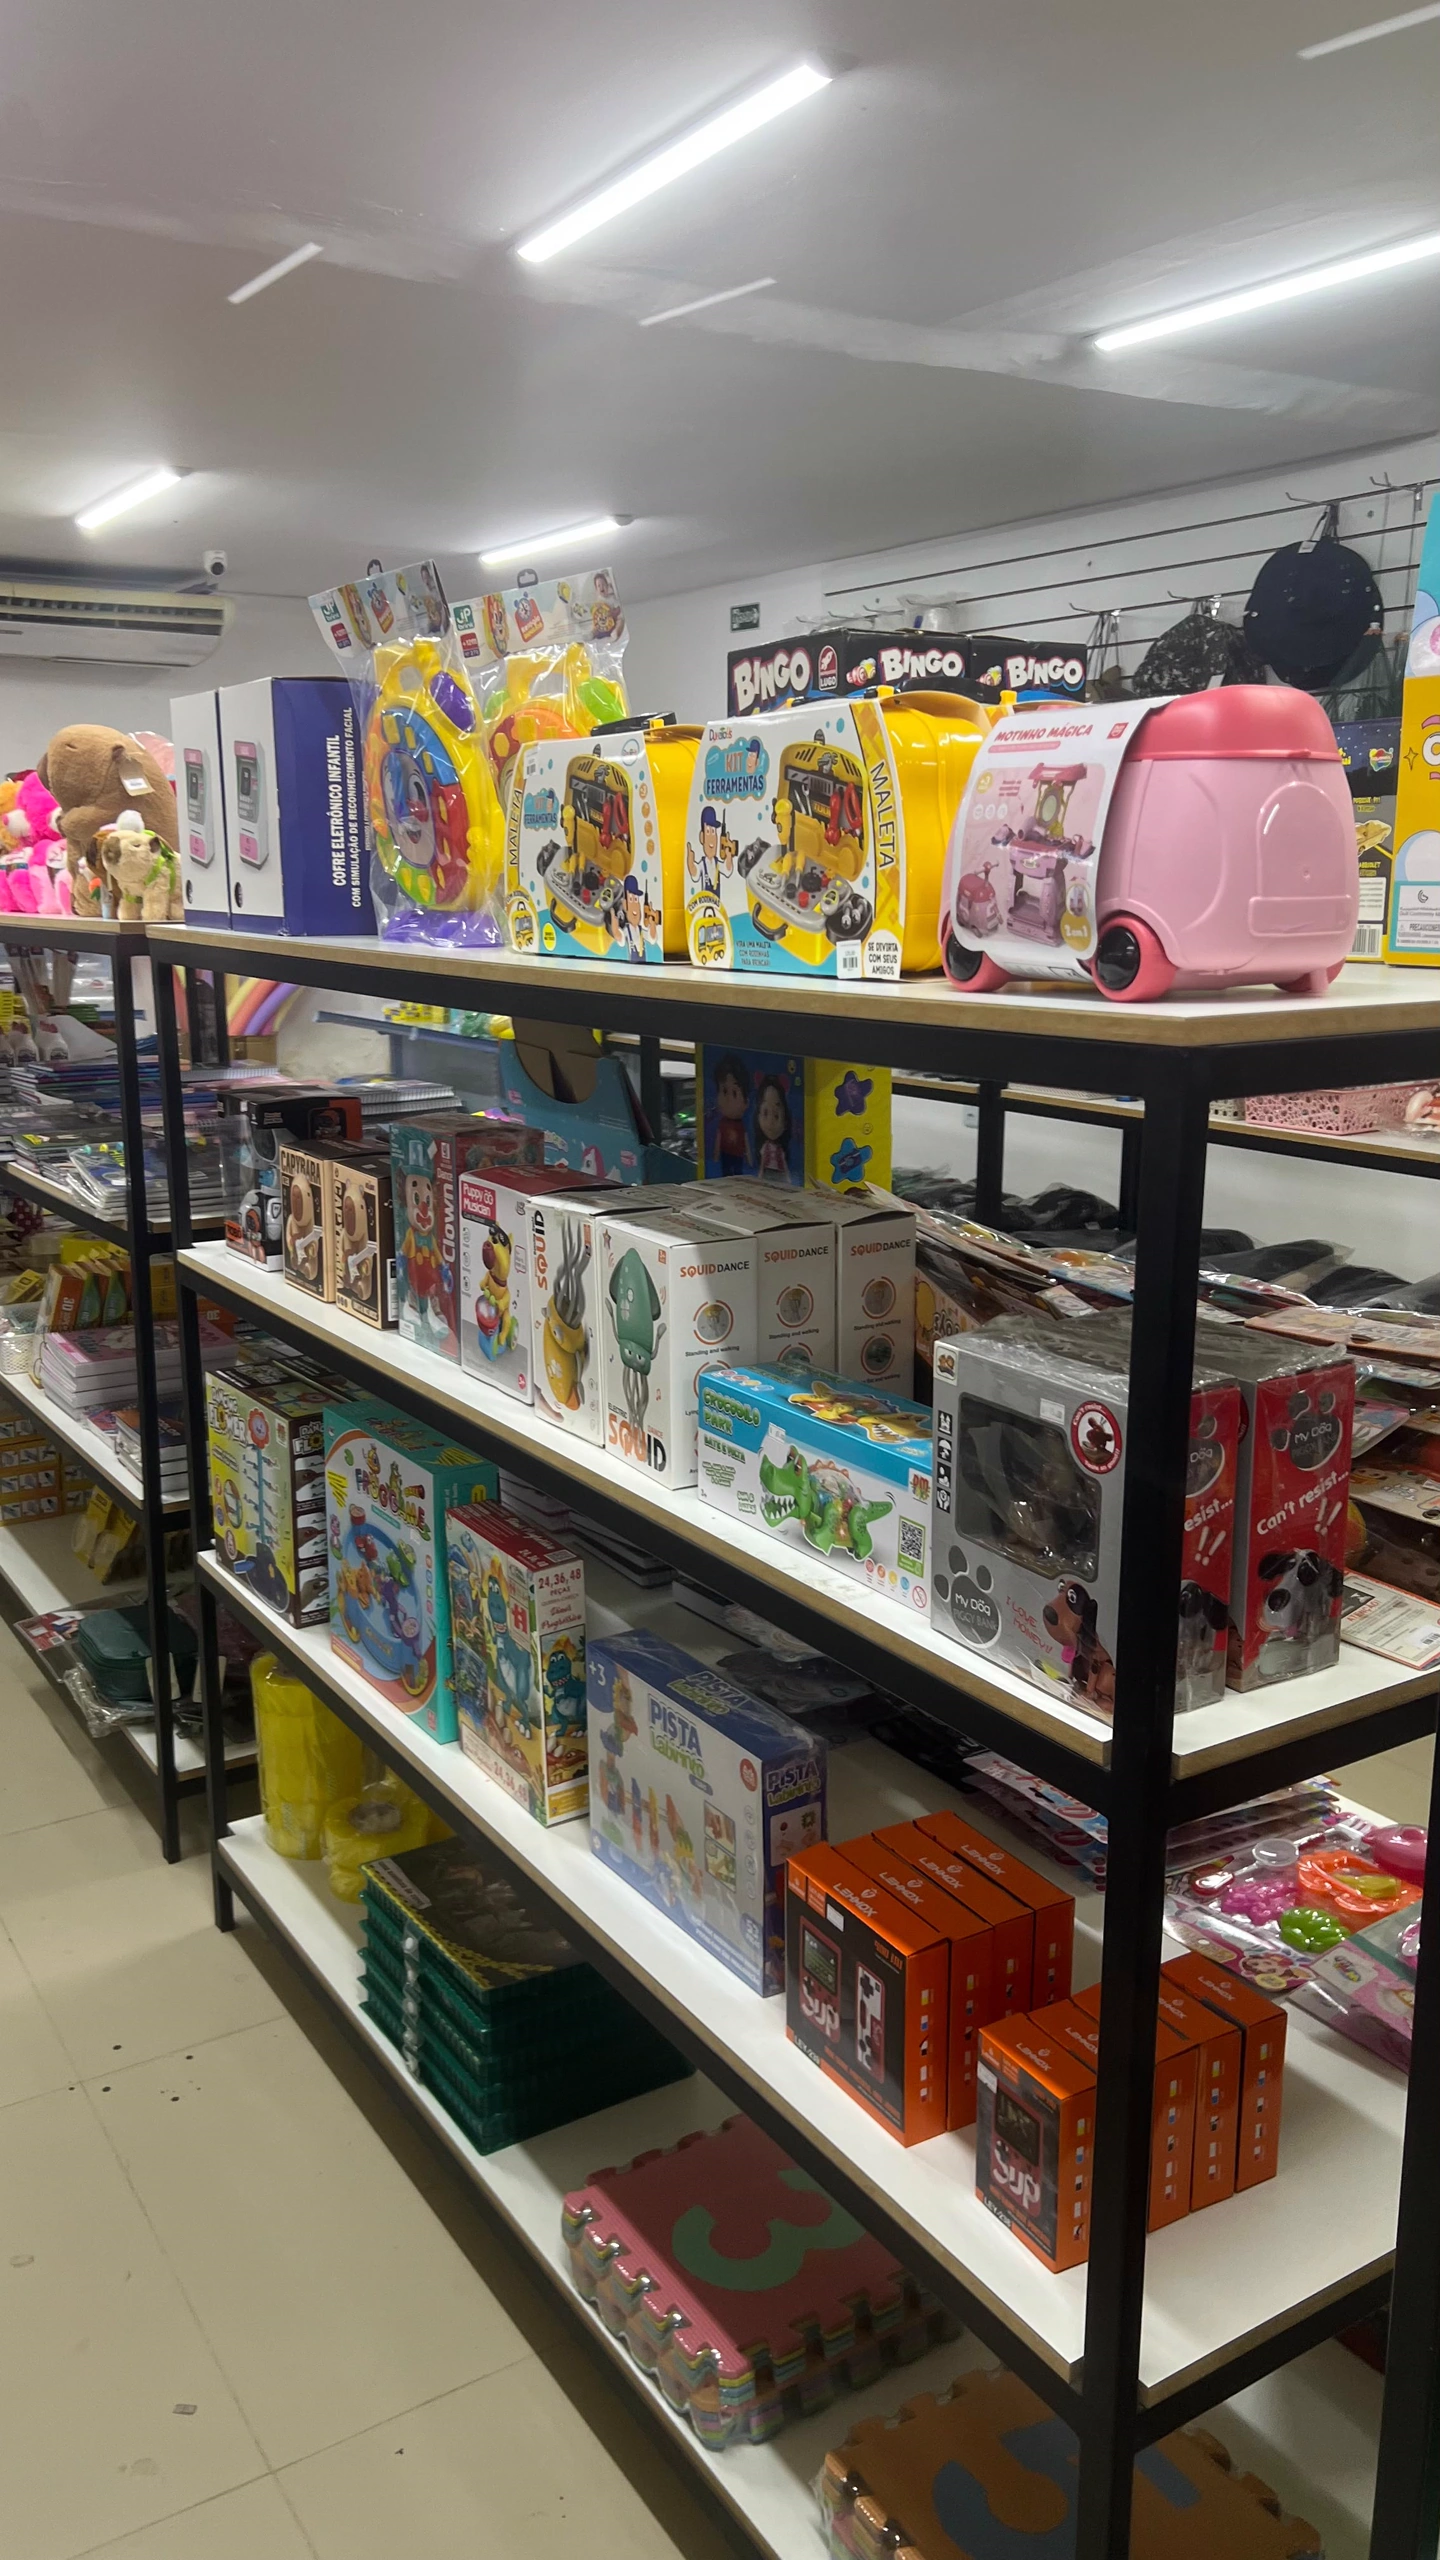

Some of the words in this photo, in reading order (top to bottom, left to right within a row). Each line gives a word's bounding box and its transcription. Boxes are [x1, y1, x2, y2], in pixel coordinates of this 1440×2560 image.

[880, 648, 964, 679] BINGO
[1005, 655, 1085, 686] BINGO
[734, 650, 811, 712] BINGO
[821, 676, 836, 687] LUGO
[343, 707, 354, 739] FACIAL
[994, 727, 1047, 742] MOTINHO
[1046, 721, 1094, 739] MÁGICA
[325, 734, 343, 783] INFANTIL
[725, 752, 742, 773] KIT
[345, 740, 359, 821] RECONHECIMENTO
[706, 774, 764, 795] FERRAMENTAS
[326, 784, 345, 850] ELETRÔNICO
[347, 822, 359, 835] DE
[509, 789, 522, 866] MALETA
[524, 811, 557, 825] FERRAMENTAS
[870, 761, 896, 870] MALETA
[332, 851, 347, 887] COFRE
[349, 835, 361, 886] SIMULAÇÃO
[351, 887, 362, 907] COM
[868, 942, 875, 951] SE
[876, 942, 898, 952] DIVIRTA
[868, 954, 882, 963] COM
[882, 955, 897, 964] SEUS
[871, 965, 895, 976] AMIGOS
[281, 1150, 322, 1186] CAPYBARA
[463, 1183, 483, 1201] Puppy
[441, 1183, 456, 1263] Clown
[463, 1199, 491, 1217] Musician
[533, 1210, 549, 1290] SQUID
[764, 1249, 798, 1263] SQUID
[799, 1246, 829, 1258] DANCE
[851, 1243, 882, 1256] SQUID
[883, 1239, 911, 1251] DANCE
[680, 1264, 716, 1278] SQUID
[717, 1260, 750, 1274] DANCE
[768, 1332, 790, 1340] Standing
[685, 1349, 708, 1358] Standing
[608, 1402, 628, 1420] ELECTRIC
[702, 1387, 761, 1427] CROCODILO
[703, 1406, 733, 1435] PARK
[207, 1401, 248, 1449] FLOWER
[608, 1414, 668, 1473] SQUID
[1183, 1498, 1234, 1532] esist...
[1256, 1501, 1296, 1536] Can't
[1298, 1470, 1350, 1509] resist...
[550, 1586, 571, 1596] PEÇAS
[955, 1593, 968, 1608] My
[953, 1608, 975, 1623] PIGGY
[976, 1614, 998, 1631] BANK
[1011, 1602, 1037, 1628] LOVE
[588, 1661, 607, 1686] +3
[686, 1670, 750, 1709] PISTA
[649, 1696, 704, 1758] PISTA
[766, 1760, 819, 1791] PISTA
[878, 1871, 924, 1905] LEHMOX
[918, 1857, 965, 1890] LEHMOX
[832, 1882, 878, 1918] LEHMOX
[801, 1983, 840, 2038] Sup
[992, 2144, 1041, 2210] Sup
